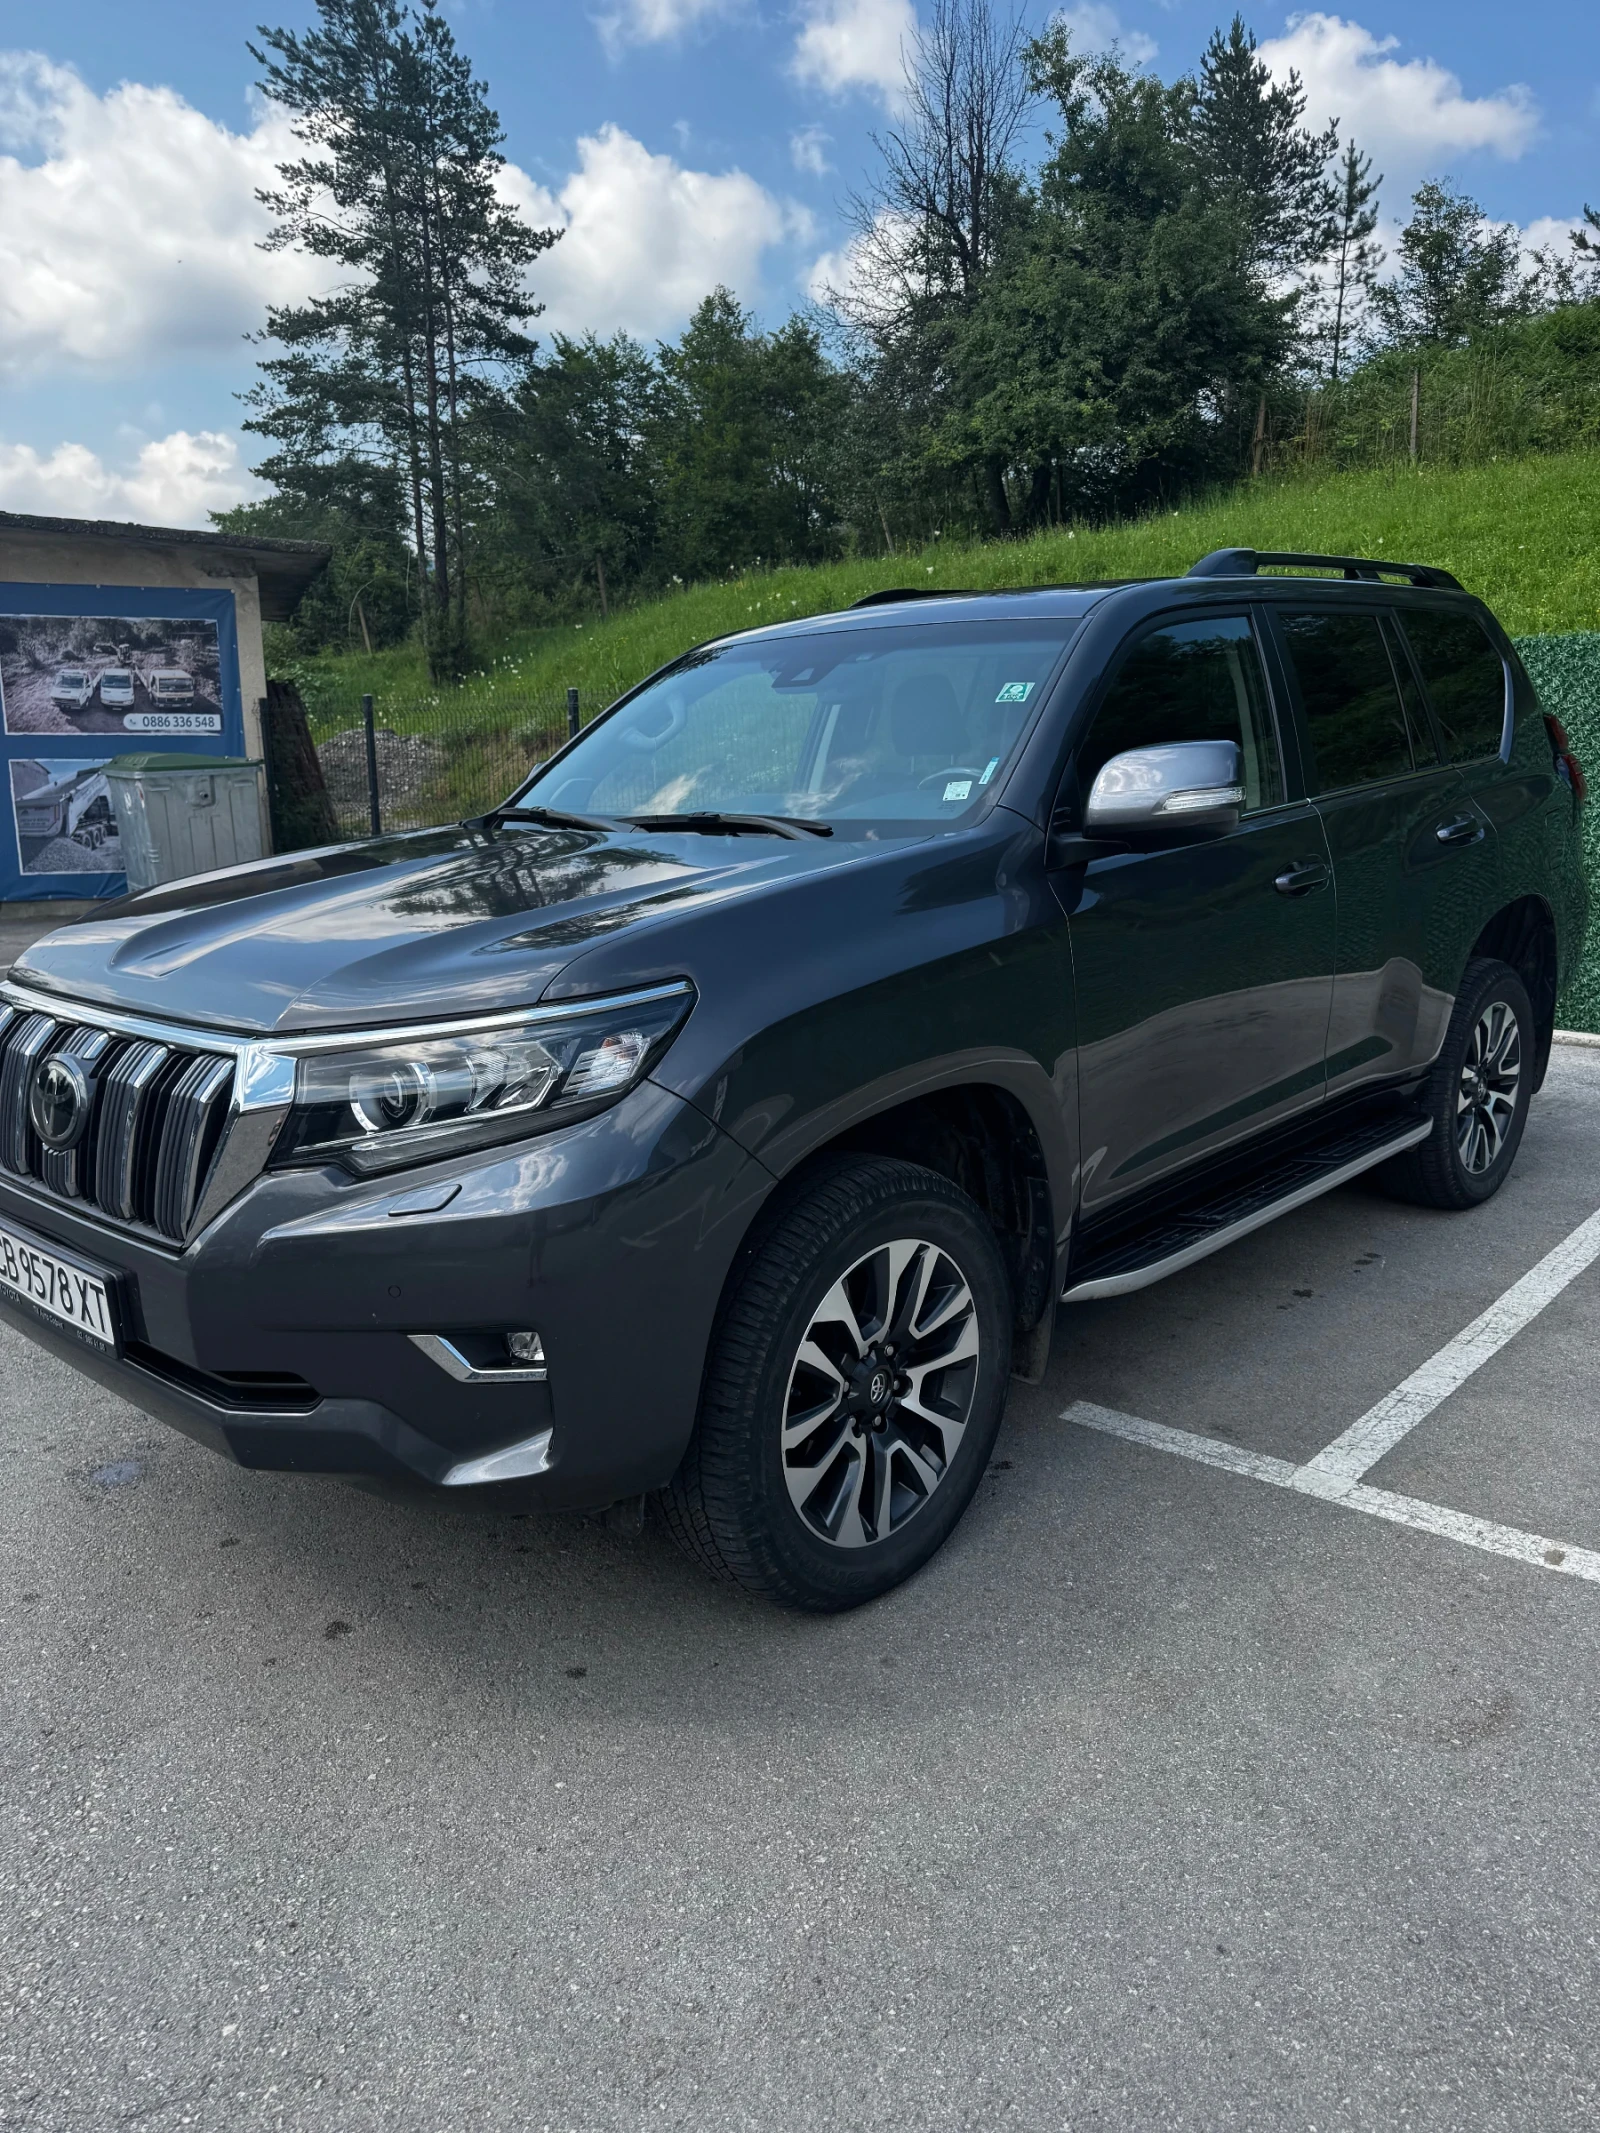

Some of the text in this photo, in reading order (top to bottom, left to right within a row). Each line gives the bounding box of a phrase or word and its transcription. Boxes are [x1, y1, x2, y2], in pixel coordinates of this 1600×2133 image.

[142, 716, 215, 728] 0886 336 548
[19, 1248, 74, 1315] 9578
[74, 1273, 107, 1334] XT
